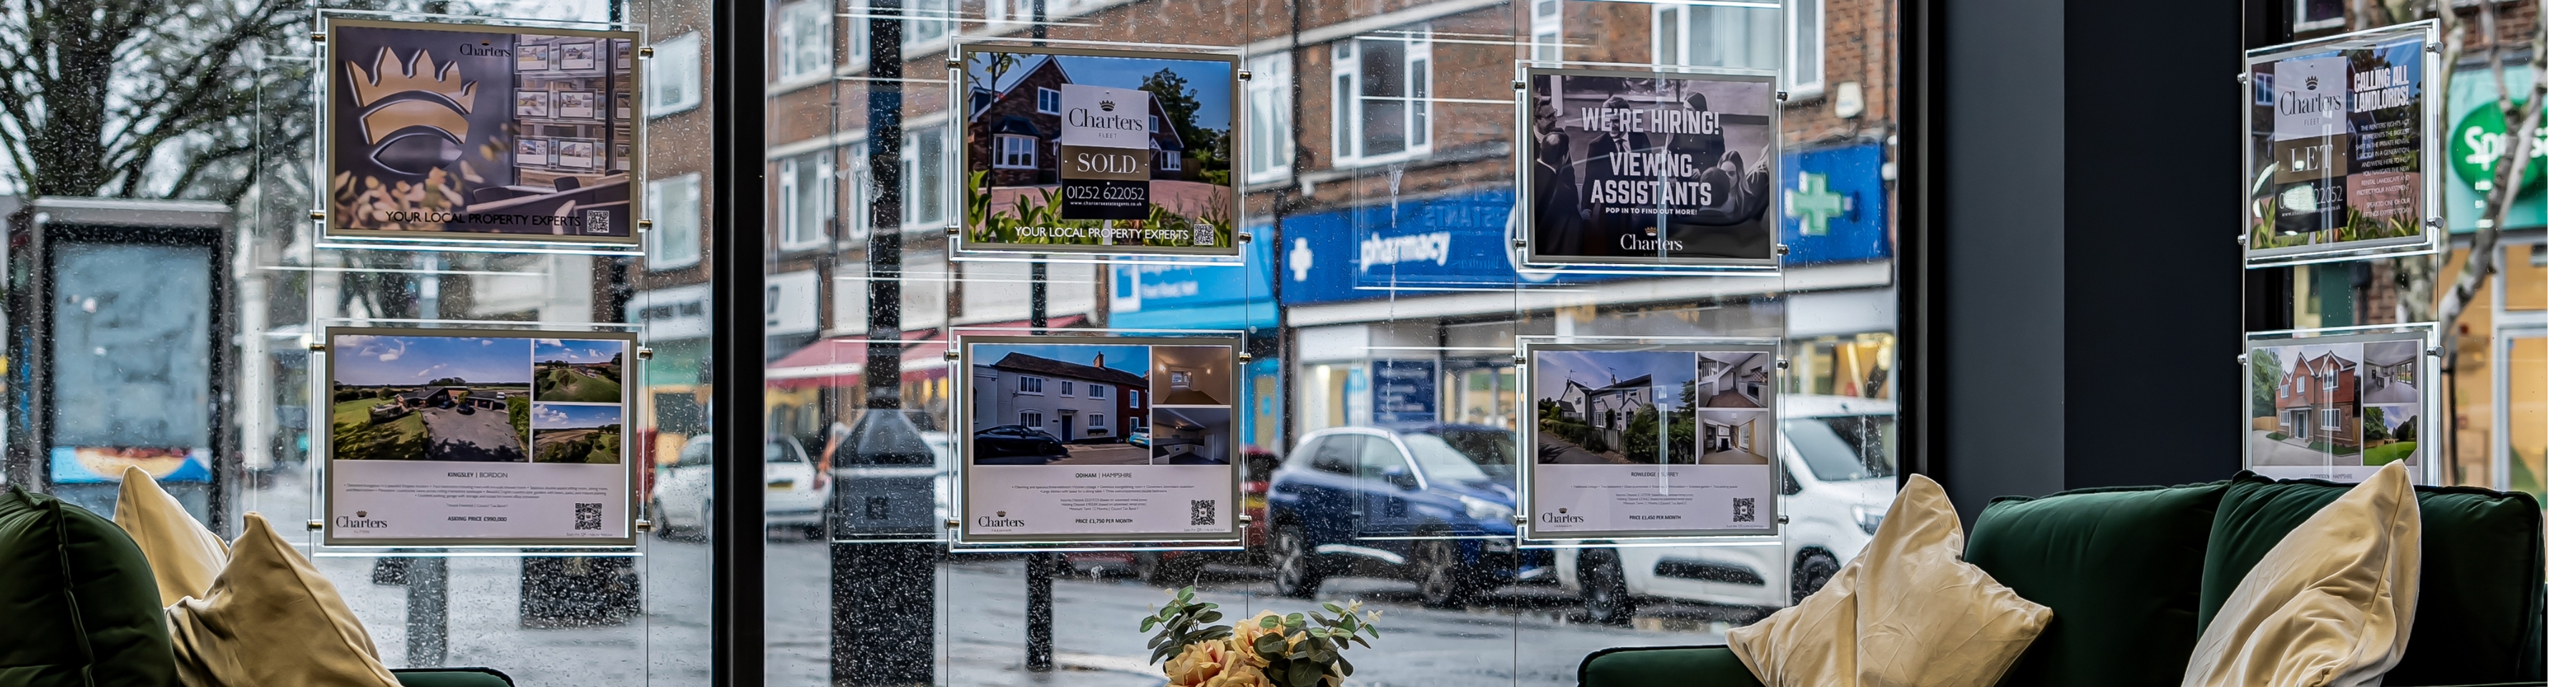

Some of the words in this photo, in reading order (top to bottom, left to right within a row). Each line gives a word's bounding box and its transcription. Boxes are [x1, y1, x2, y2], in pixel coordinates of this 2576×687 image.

[459, 43, 511, 57] Charters
[2354, 68, 2390, 92] CALLING
[2393, 65, 2409, 86] ALL
[2280, 90, 2341, 116] Charters
[2354, 85, 2409, 113] LANDLORDS!
[1068, 107, 1143, 131] Charters
[1582, 107, 1644, 132] WE'RE
[1651, 109, 1719, 135] HIRING!
[1078, 152, 1136, 173] SOLD
[1610, 152, 1692, 177] VIEWING
[2290, 144, 2333, 172] LET
[1067, 186, 1100, 199] 01252
[1103, 187, 1144, 200] 622052
[1591, 180, 1712, 205] ASSISTANTS
[386, 211, 421, 222] YOUR
[424, 213, 465, 223] LOCAL
[469, 214, 528, 225] PROPERTY
[532, 216, 581, 226] EXPERTS
[1015, 227, 1046, 237] YOUR
[1049, 228, 1085, 238] LOCAL
[1088, 228, 1141, 239] PROPERTY
[1145, 229, 1189, 240] EXPERTS
[1620, 233, 1683, 250] Charters
[1360, 231, 1450, 276] pharmacy
[336, 516, 387, 527] Charters
[978, 516, 1025, 527] Charters
[1542, 512, 1584, 522] Charters
